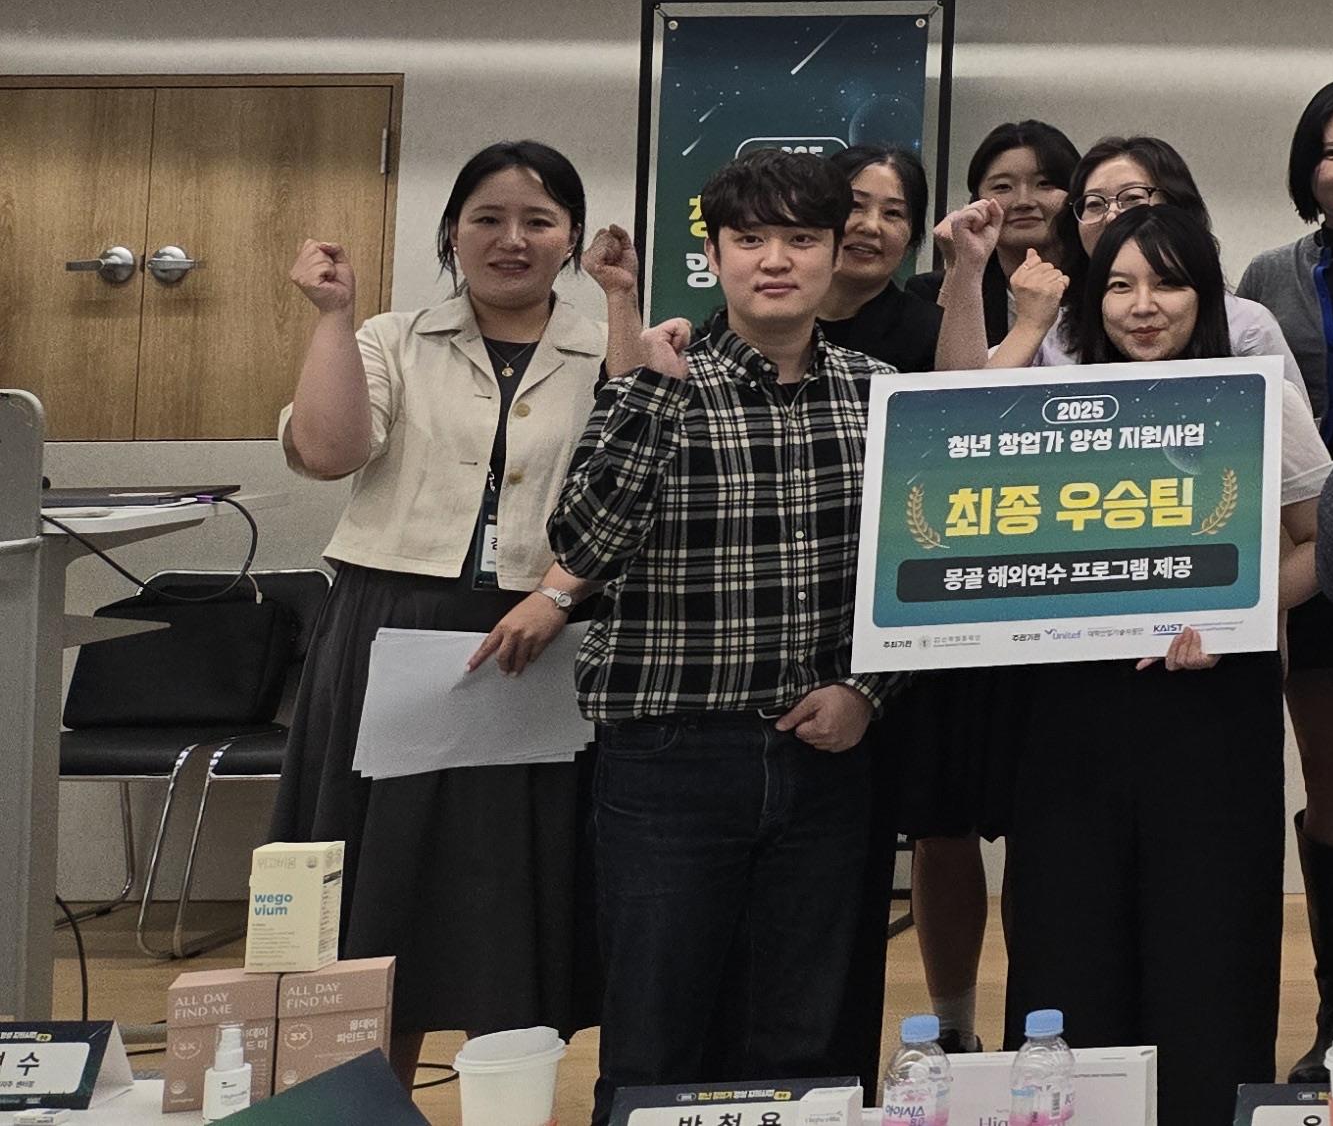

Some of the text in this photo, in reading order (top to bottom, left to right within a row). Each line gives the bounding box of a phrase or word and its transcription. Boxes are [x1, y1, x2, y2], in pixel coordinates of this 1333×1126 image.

[1057, 401, 1103, 419] 2025
[948, 424, 1205, 458] 청년 창업가 양성 지원사업
[945, 477, 1194, 537] 최종 우승팀
[943, 556, 1192, 590] 몽골 해외연수 프로그램 제공
[1052, 630, 1081, 640] Unitef
[1153, 624, 1183, 632] KAIST
[254, 894, 293, 905] wego
[254, 905, 288, 915] vium
[286, 982, 341, 997] ALL DAY
[175, 993, 229, 1007] ALL DAY
[286, 994, 344, 1009] FIND ME
[175, 1004, 232, 1019] FIND ME
[17, 1052, 40, 1076] 수
